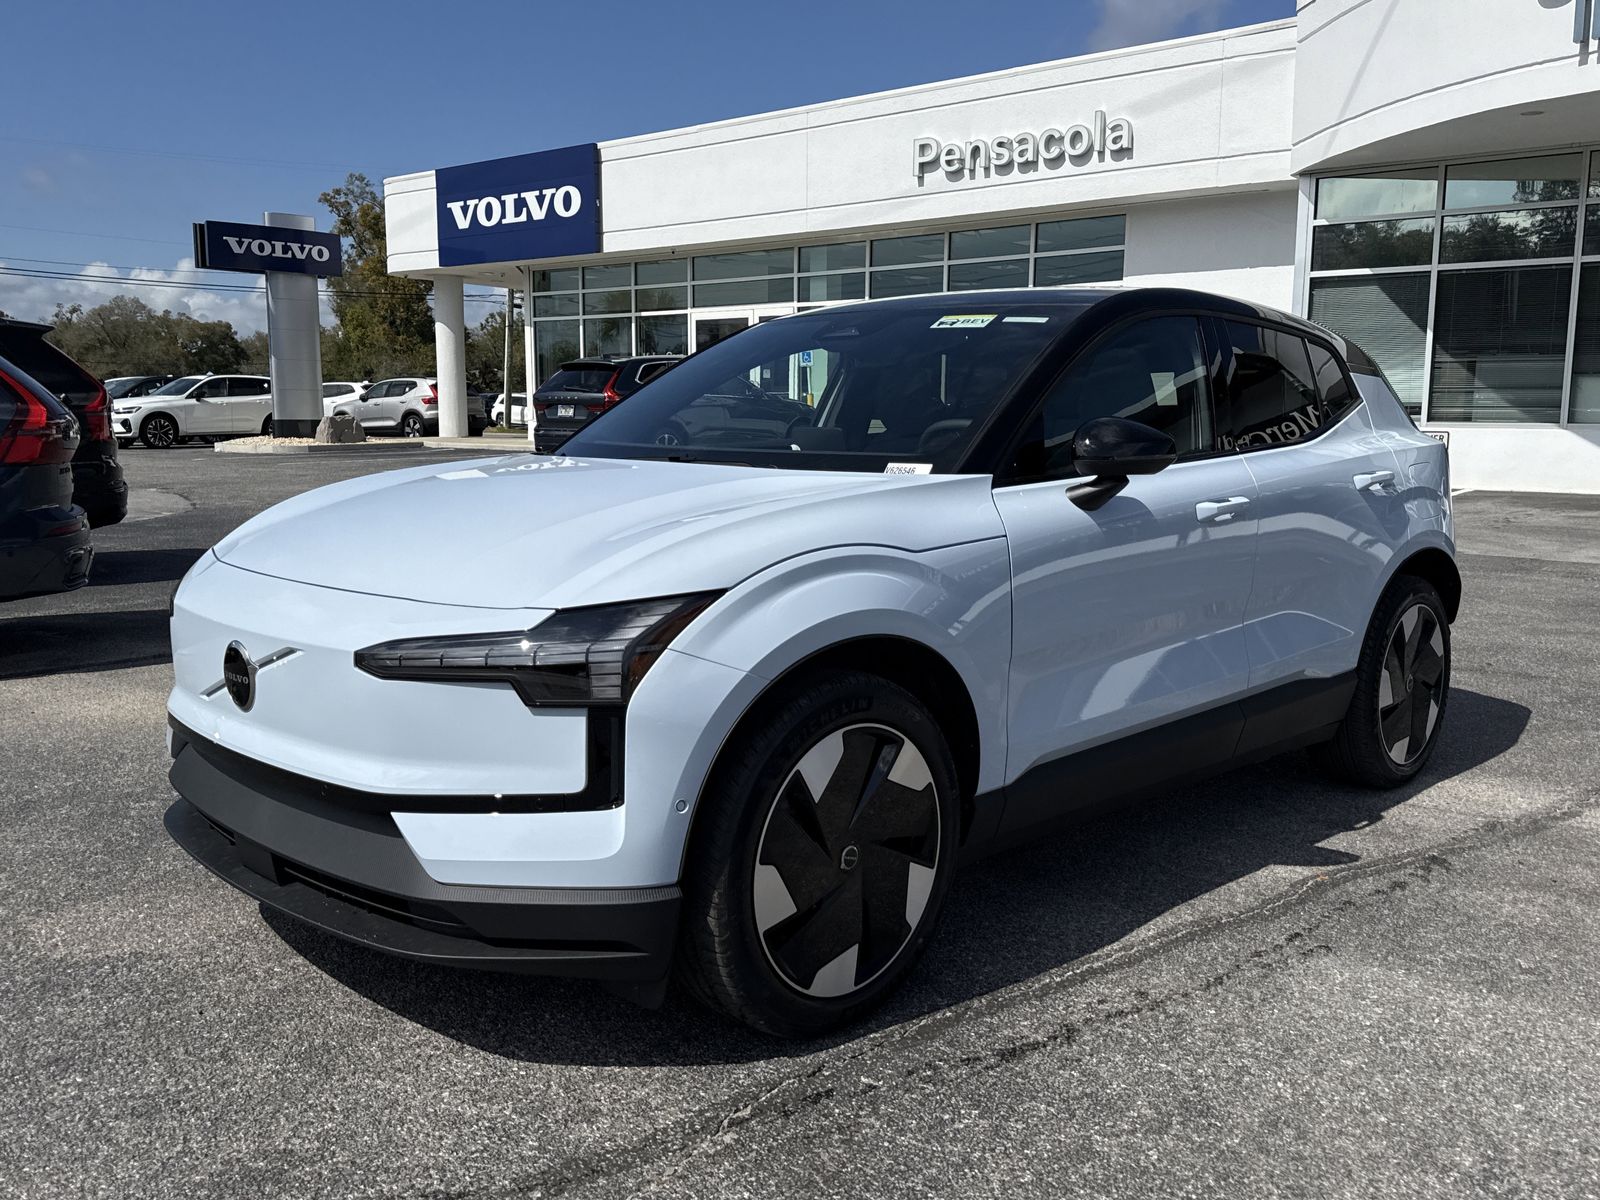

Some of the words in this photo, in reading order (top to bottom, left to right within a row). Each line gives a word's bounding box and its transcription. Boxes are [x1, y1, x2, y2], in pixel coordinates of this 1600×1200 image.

[912, 110, 1133, 177] Pensacola
[447, 185, 582, 230] VOLVO
[223, 236, 330, 262] VOLVO
[225, 671, 249, 685] VOLVO
